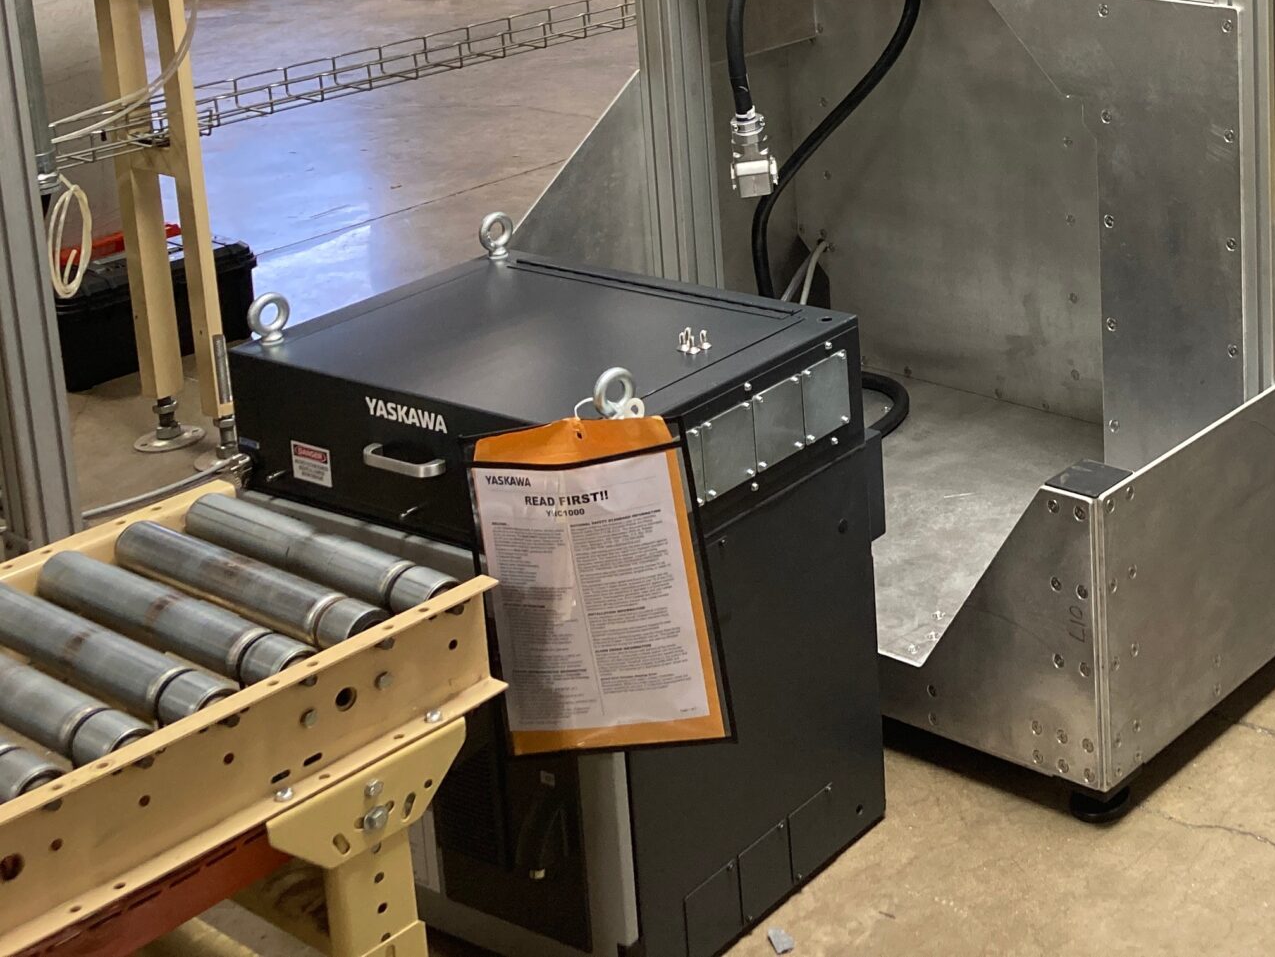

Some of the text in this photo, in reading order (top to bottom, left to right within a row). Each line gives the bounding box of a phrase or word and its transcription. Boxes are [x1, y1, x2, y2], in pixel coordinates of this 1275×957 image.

[365, 396, 448, 434] YASKAWA
[485, 475, 532, 488] YASKAWA
[524, 490, 609, 506] READ FIRST!!
